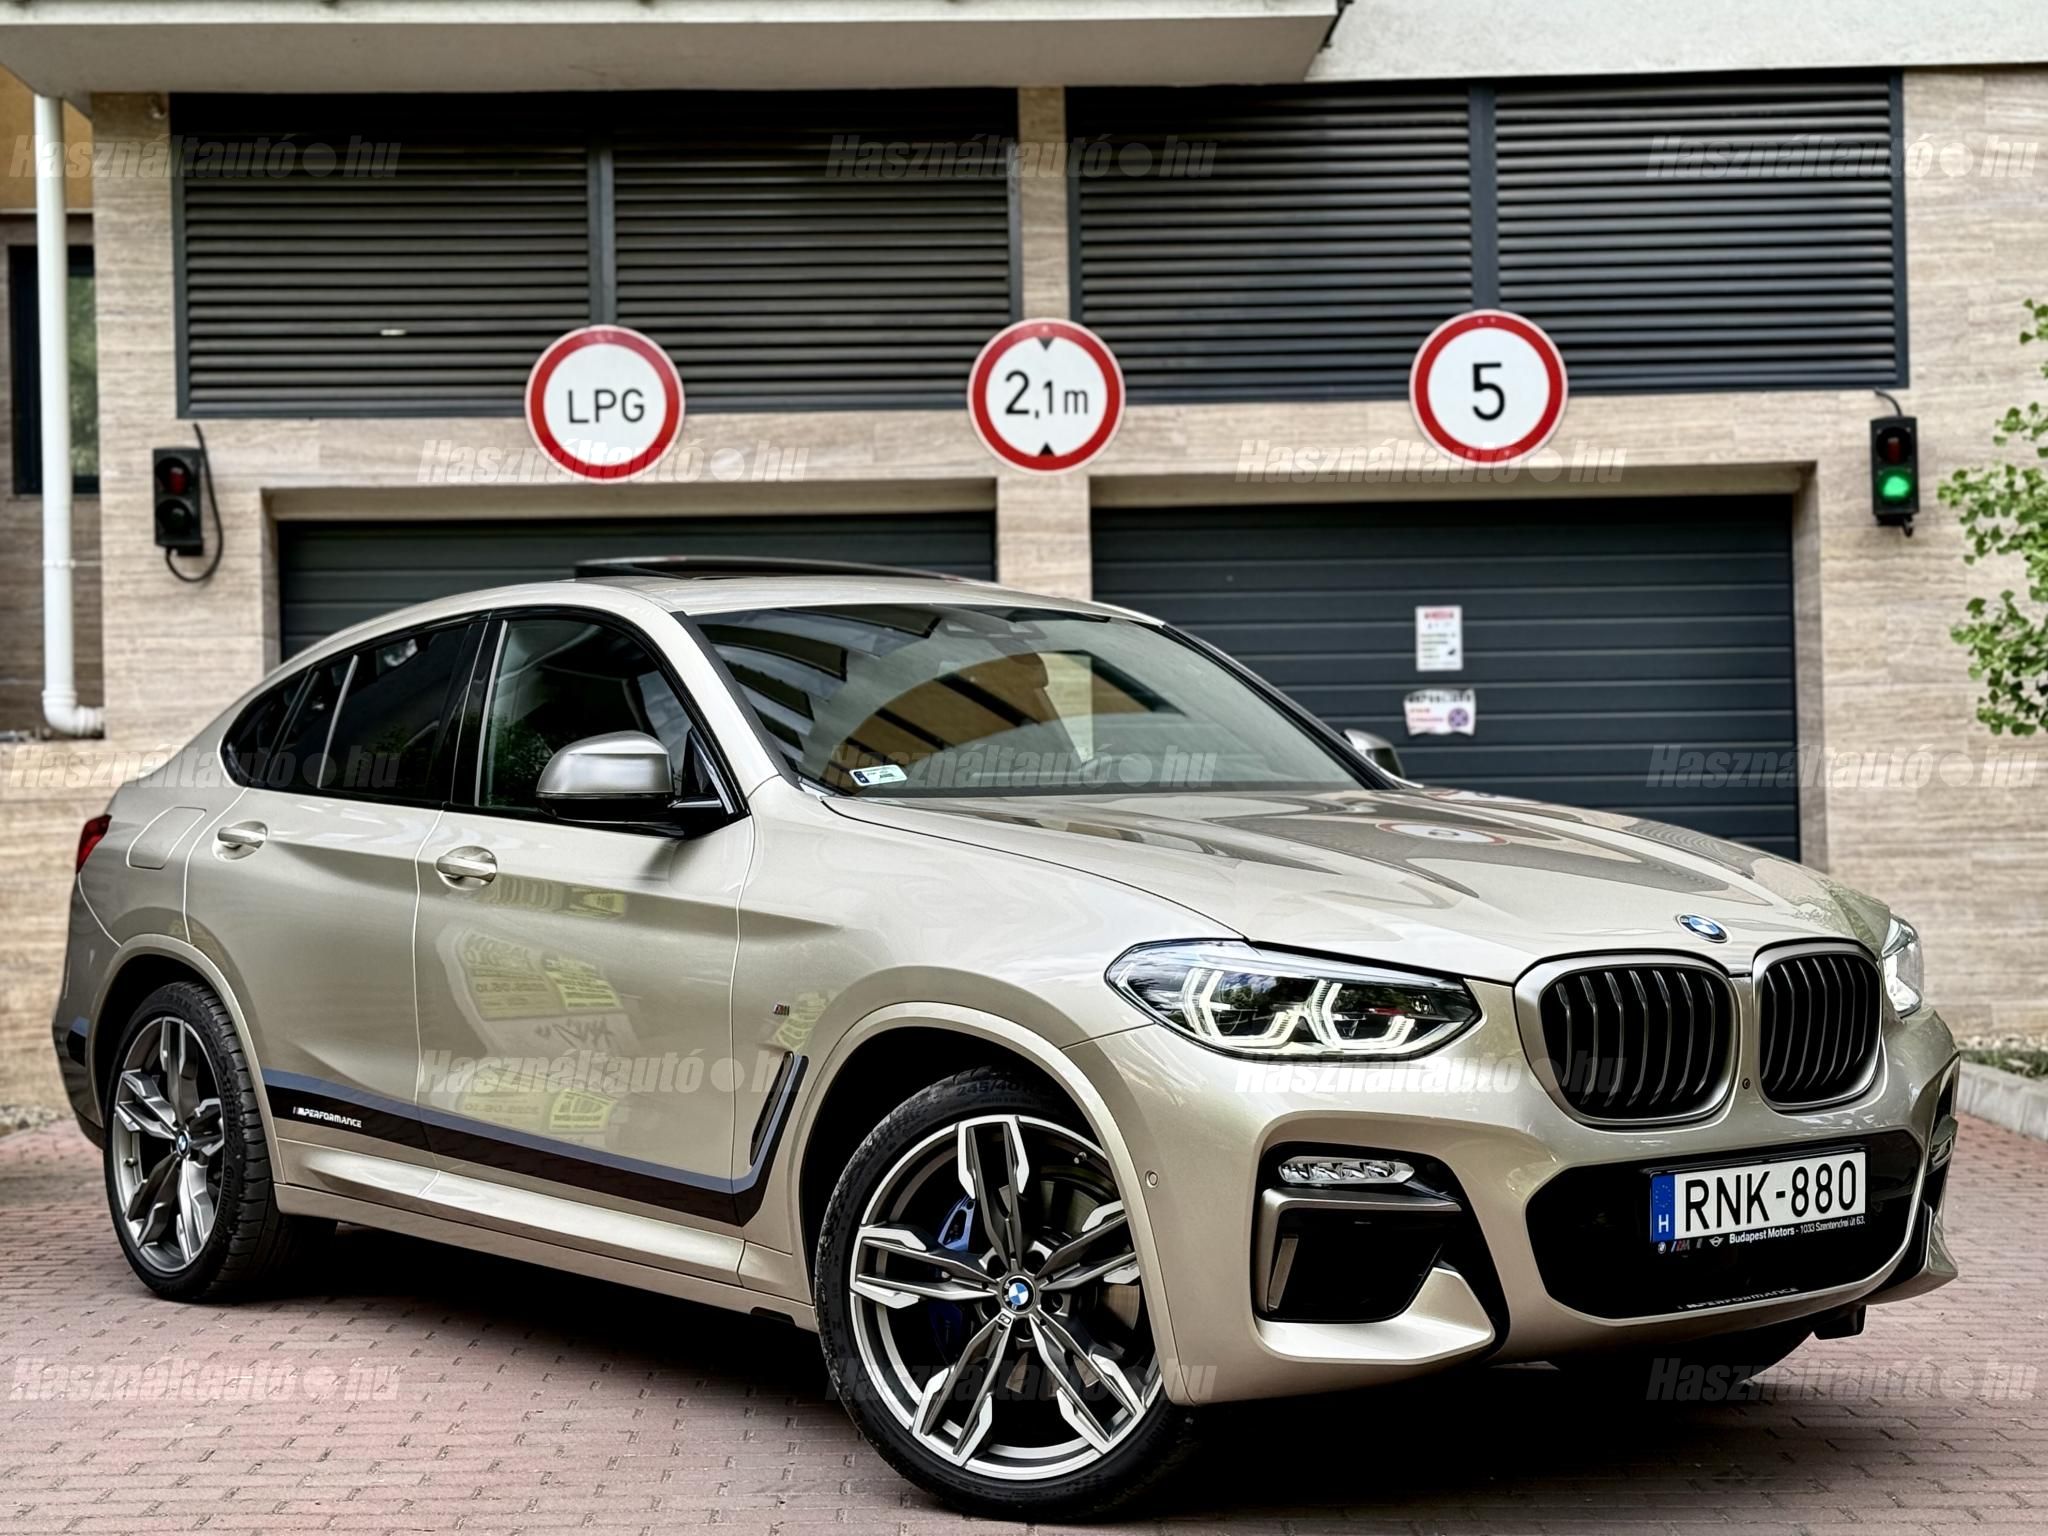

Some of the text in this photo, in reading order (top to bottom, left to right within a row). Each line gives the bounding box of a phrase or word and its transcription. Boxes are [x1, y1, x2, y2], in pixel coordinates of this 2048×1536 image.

[567, 388, 646, 424] LPG
[1472, 361, 1506, 422] 5
[1685, 1159, 1857, 1233] RNK-880
[1658, 1213, 1670, 1234] H
[1729, 1229, 1767, 1244] Budapest
[1767, 1226, 1795, 1239] Motors
[1800, 1223, 1816, 1234] 1033
